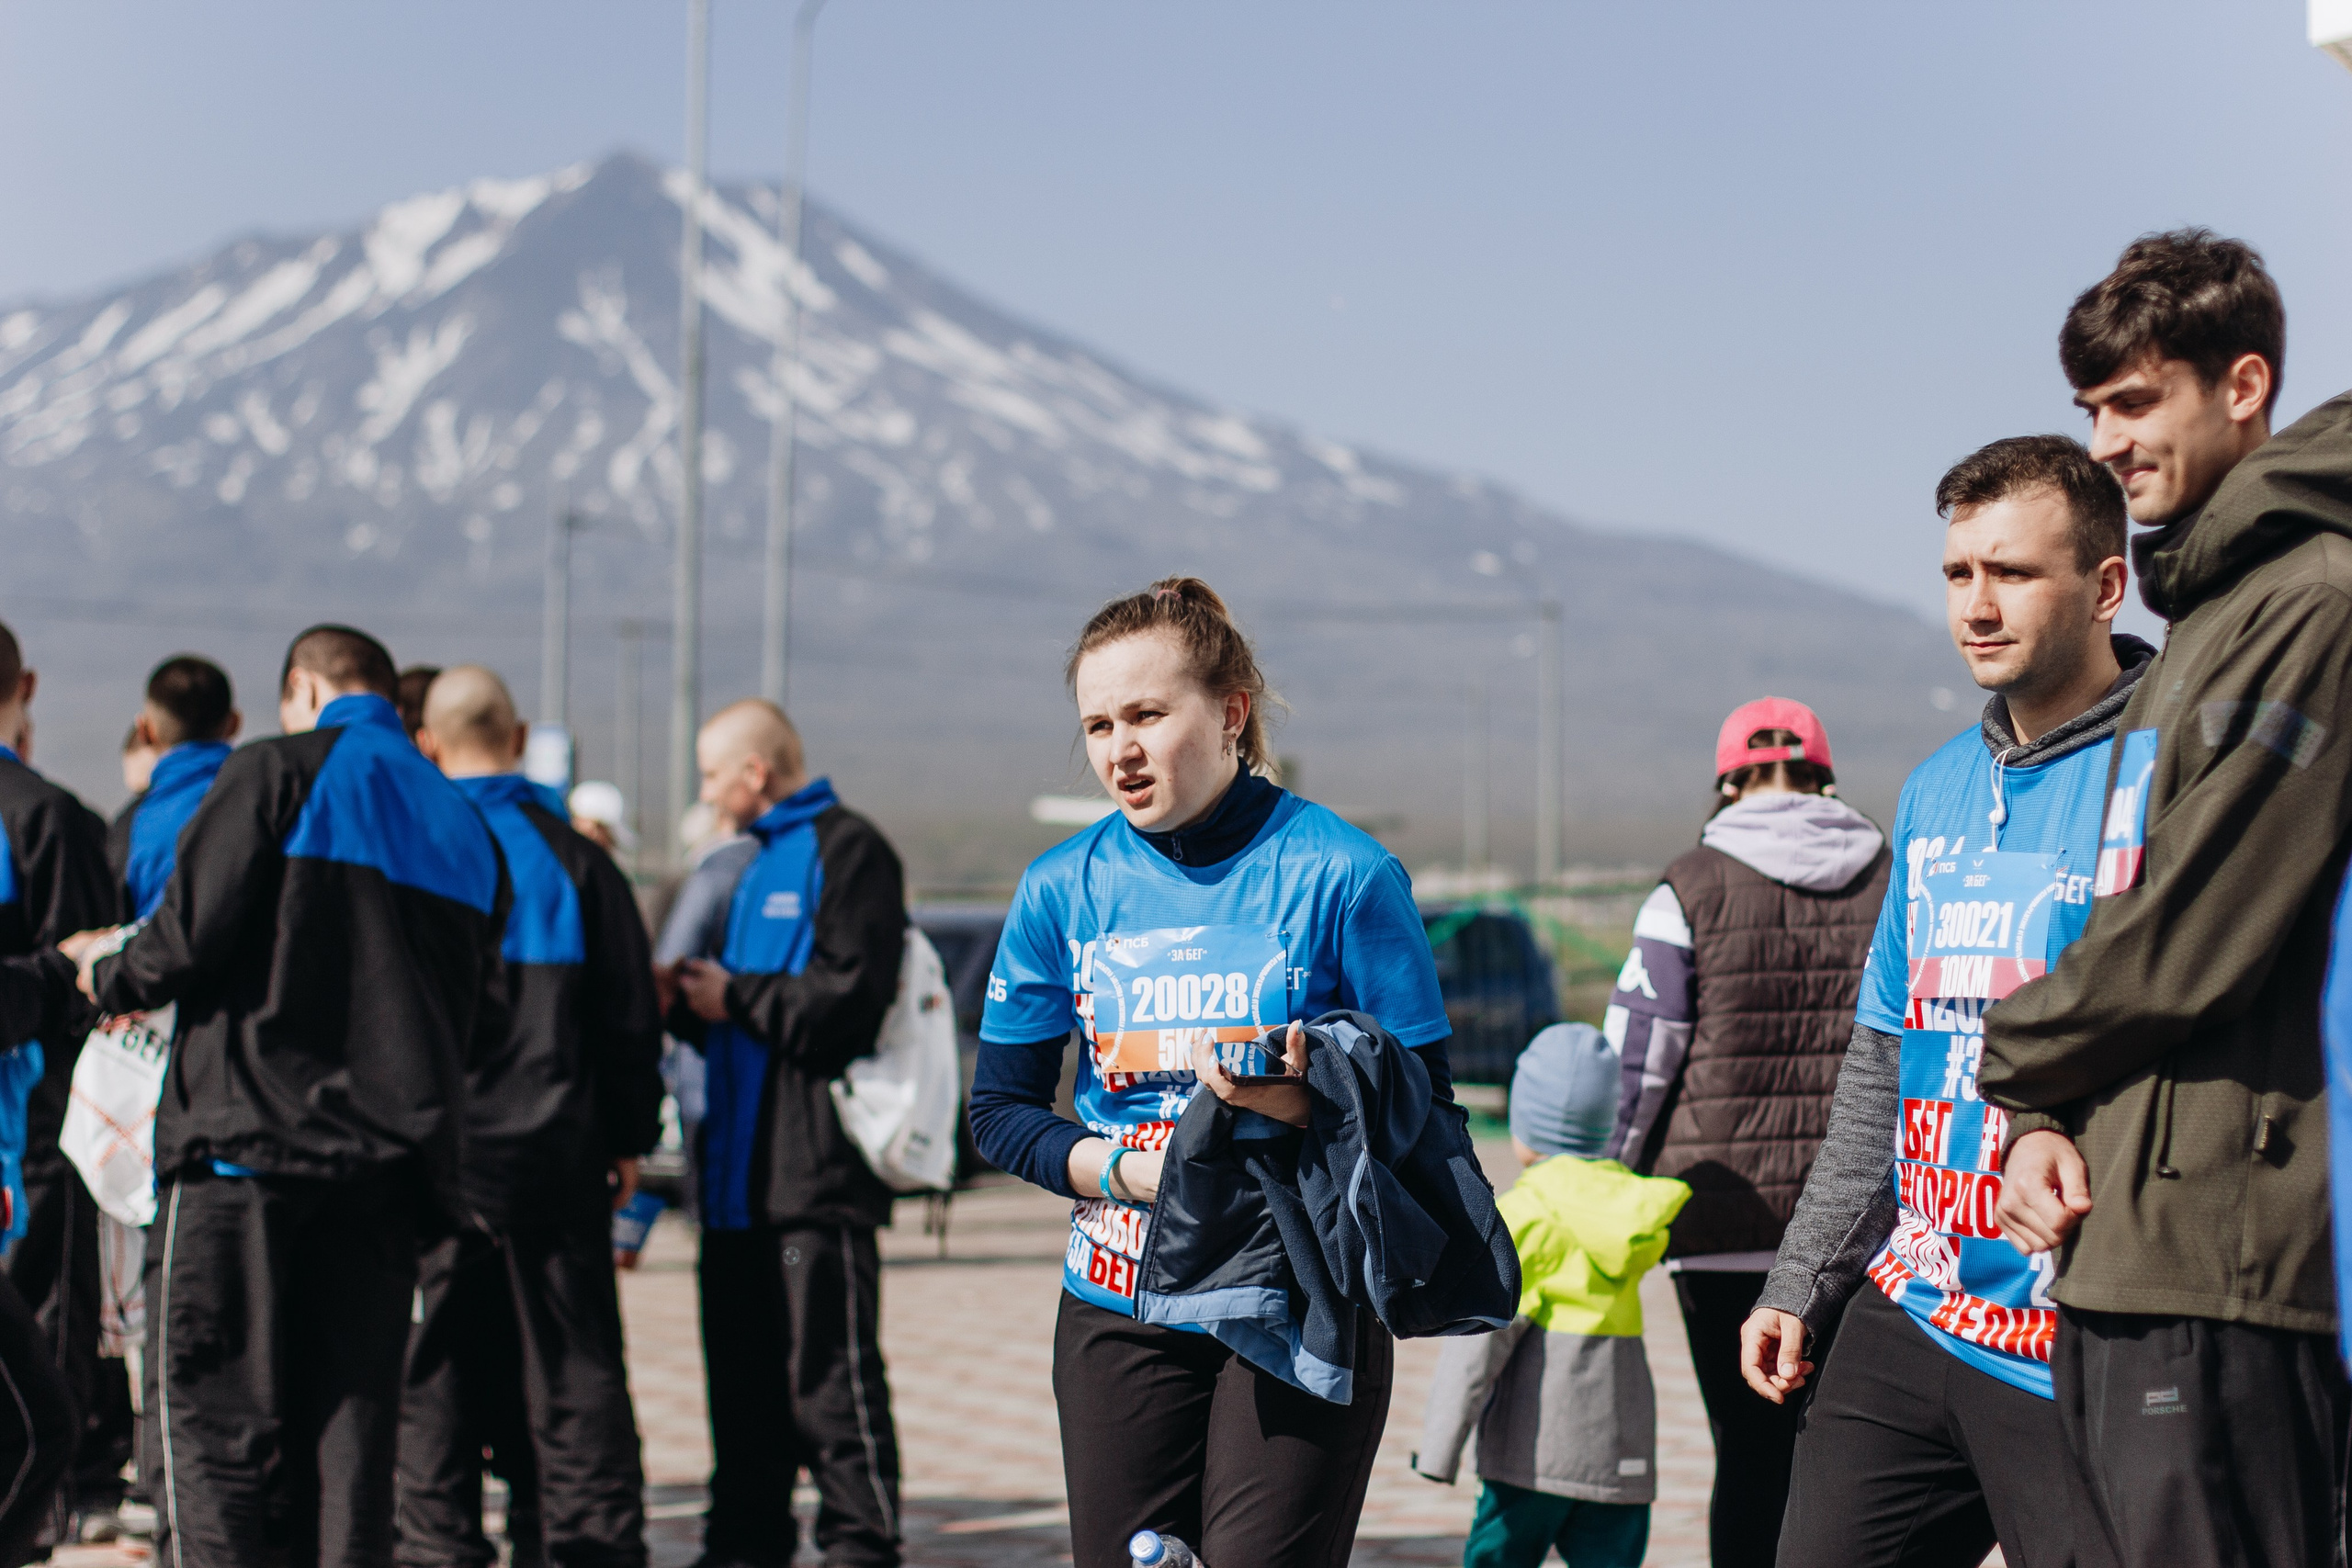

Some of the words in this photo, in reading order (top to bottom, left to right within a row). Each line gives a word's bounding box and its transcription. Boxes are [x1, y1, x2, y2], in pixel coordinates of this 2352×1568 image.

[1939, 862, 1957, 874] ПСБ
[1934, 900, 2014, 949] 30021
[1123, 937, 1149, 950] ПСБ
[987, 971, 1008, 1003] СБ
[1131, 972, 1250, 1023] 20028
[2142, 1404, 2188, 1416] PORSCHE
